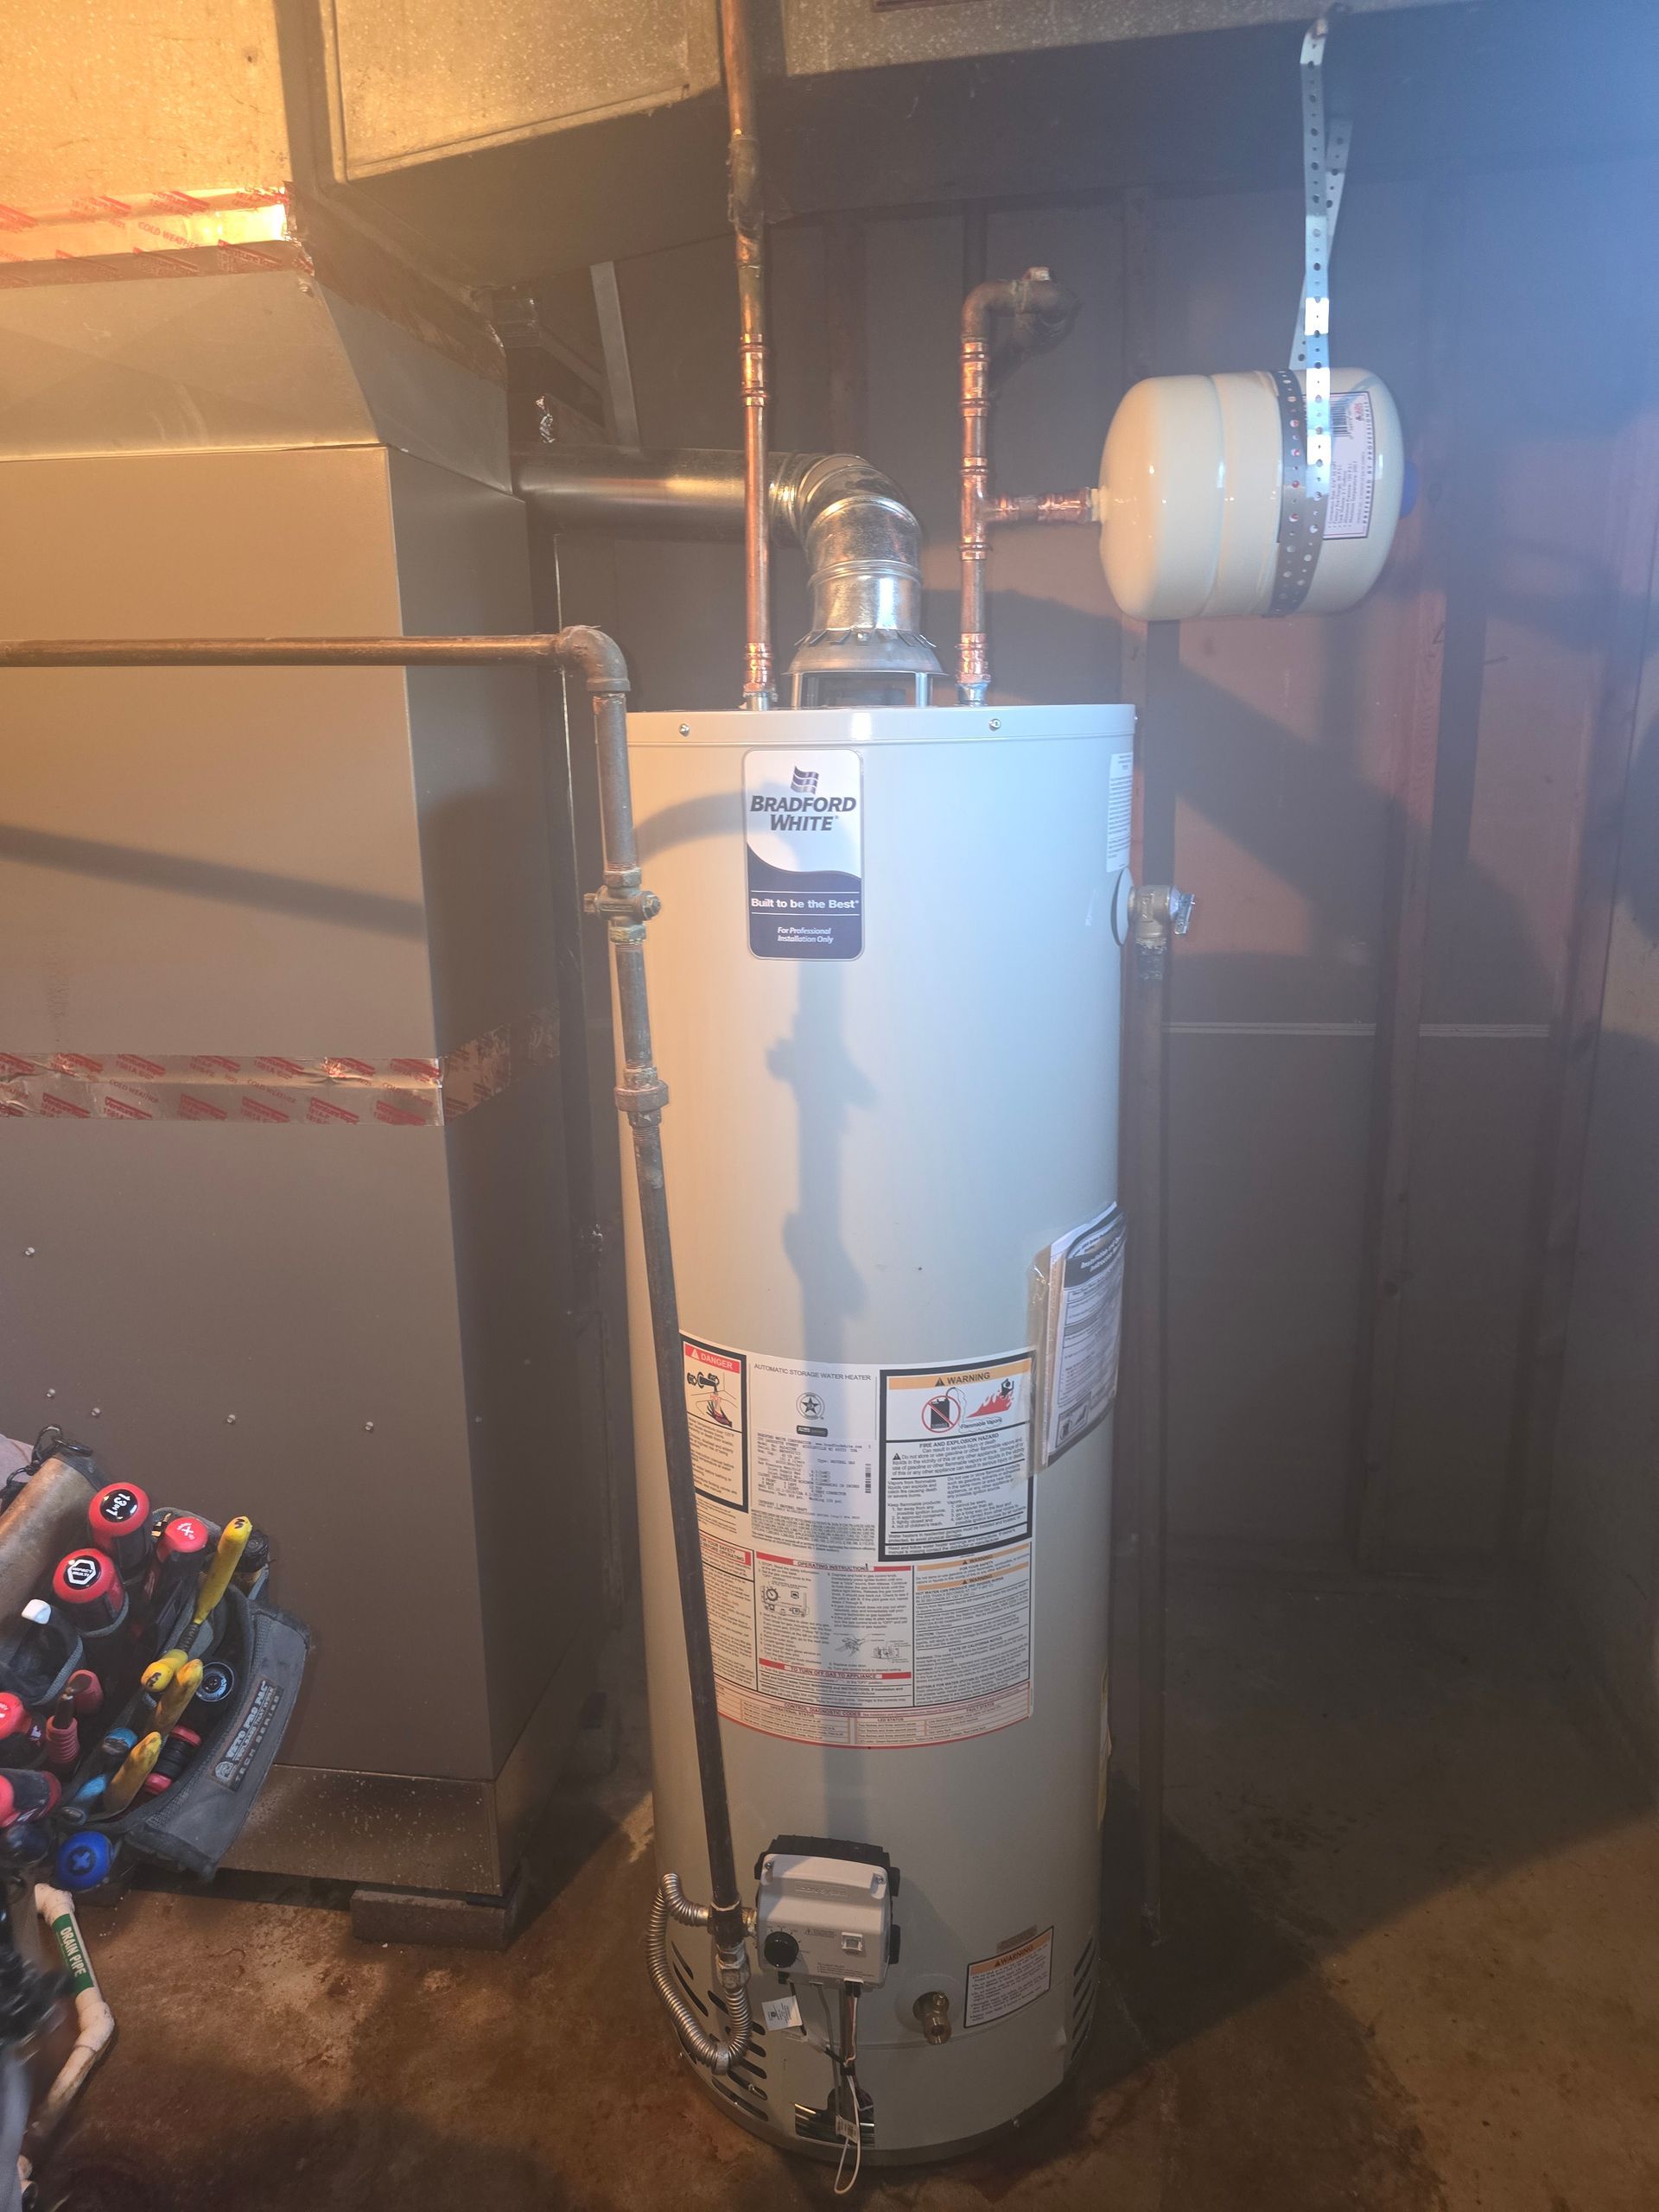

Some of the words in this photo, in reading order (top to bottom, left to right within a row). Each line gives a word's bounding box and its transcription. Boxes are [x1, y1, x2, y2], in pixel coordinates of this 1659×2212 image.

[750, 795, 856, 812] BRADFORD
[751, 899, 774, 909] Built
[791, 899, 804, 909] be
[808, 899, 825, 909] the
[701, 1353, 733, 1370] DANGER
[753, 1363, 789, 1375] AUTOMATIC
[789, 1369, 820, 1378] STORAGE
[946, 1372, 990, 1384] WARNING
[960, 1421, 987, 1430] Flammable
[987, 1418, 1002, 1427] Vapors
[946, 1438, 976, 1446] EXPLOSION
[978, 1433, 999, 1441] HAZARD
[785, 1702, 809, 1712] CONTROL
[809, 1707, 841, 1715] DIAGNOSTIC
[226, 1730, 246, 1758] VETO
[243, 1706, 258, 1729] PRO
[60, 1926, 79, 1956] DRAIN
[1000, 1944, 1034, 1965] WARNING
[69, 1953, 86, 1977] PIPE
